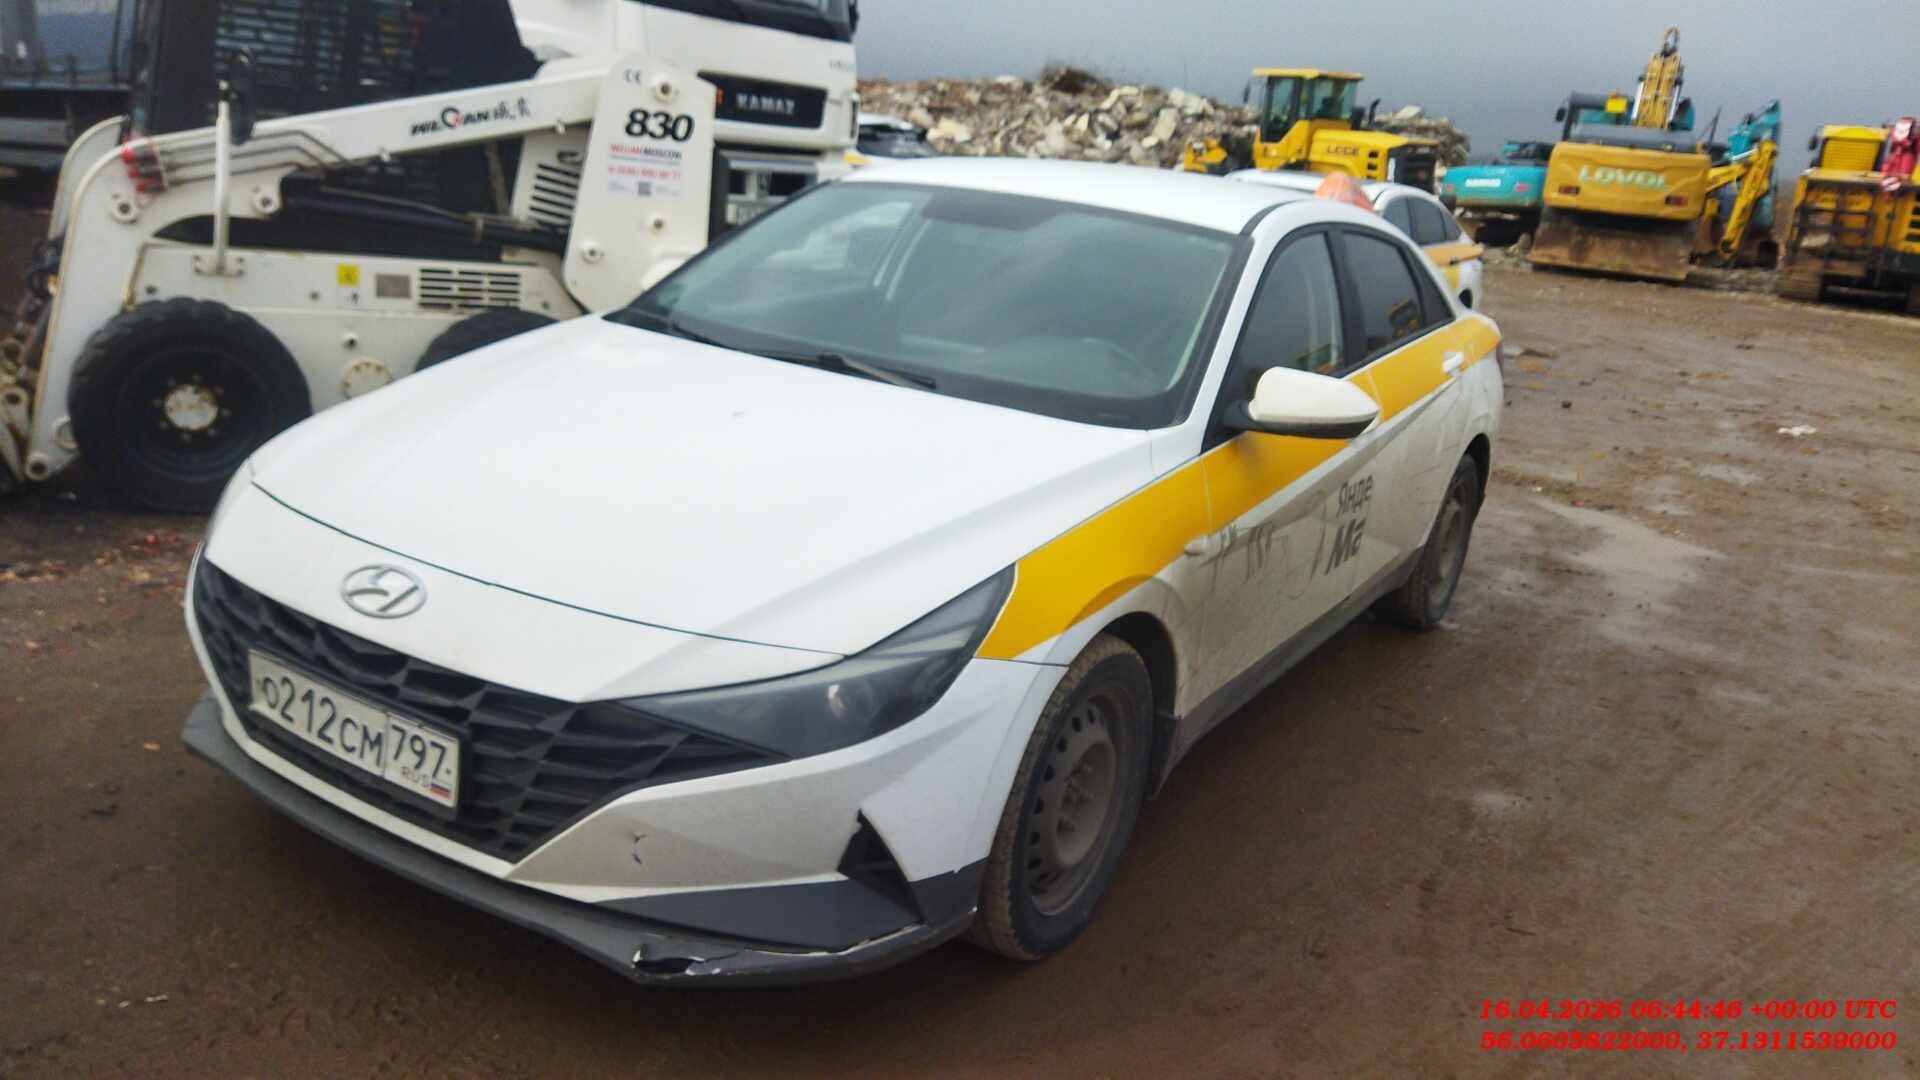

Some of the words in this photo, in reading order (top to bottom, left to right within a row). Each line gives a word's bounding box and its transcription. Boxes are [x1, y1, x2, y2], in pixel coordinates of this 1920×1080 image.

[735, 92, 796, 115] KAMAZ
[625, 108, 695, 142] 830
[1578, 164, 1668, 191] LOVOL
[391, 724, 447, 778] 797
[402, 766, 430, 789] RUS
